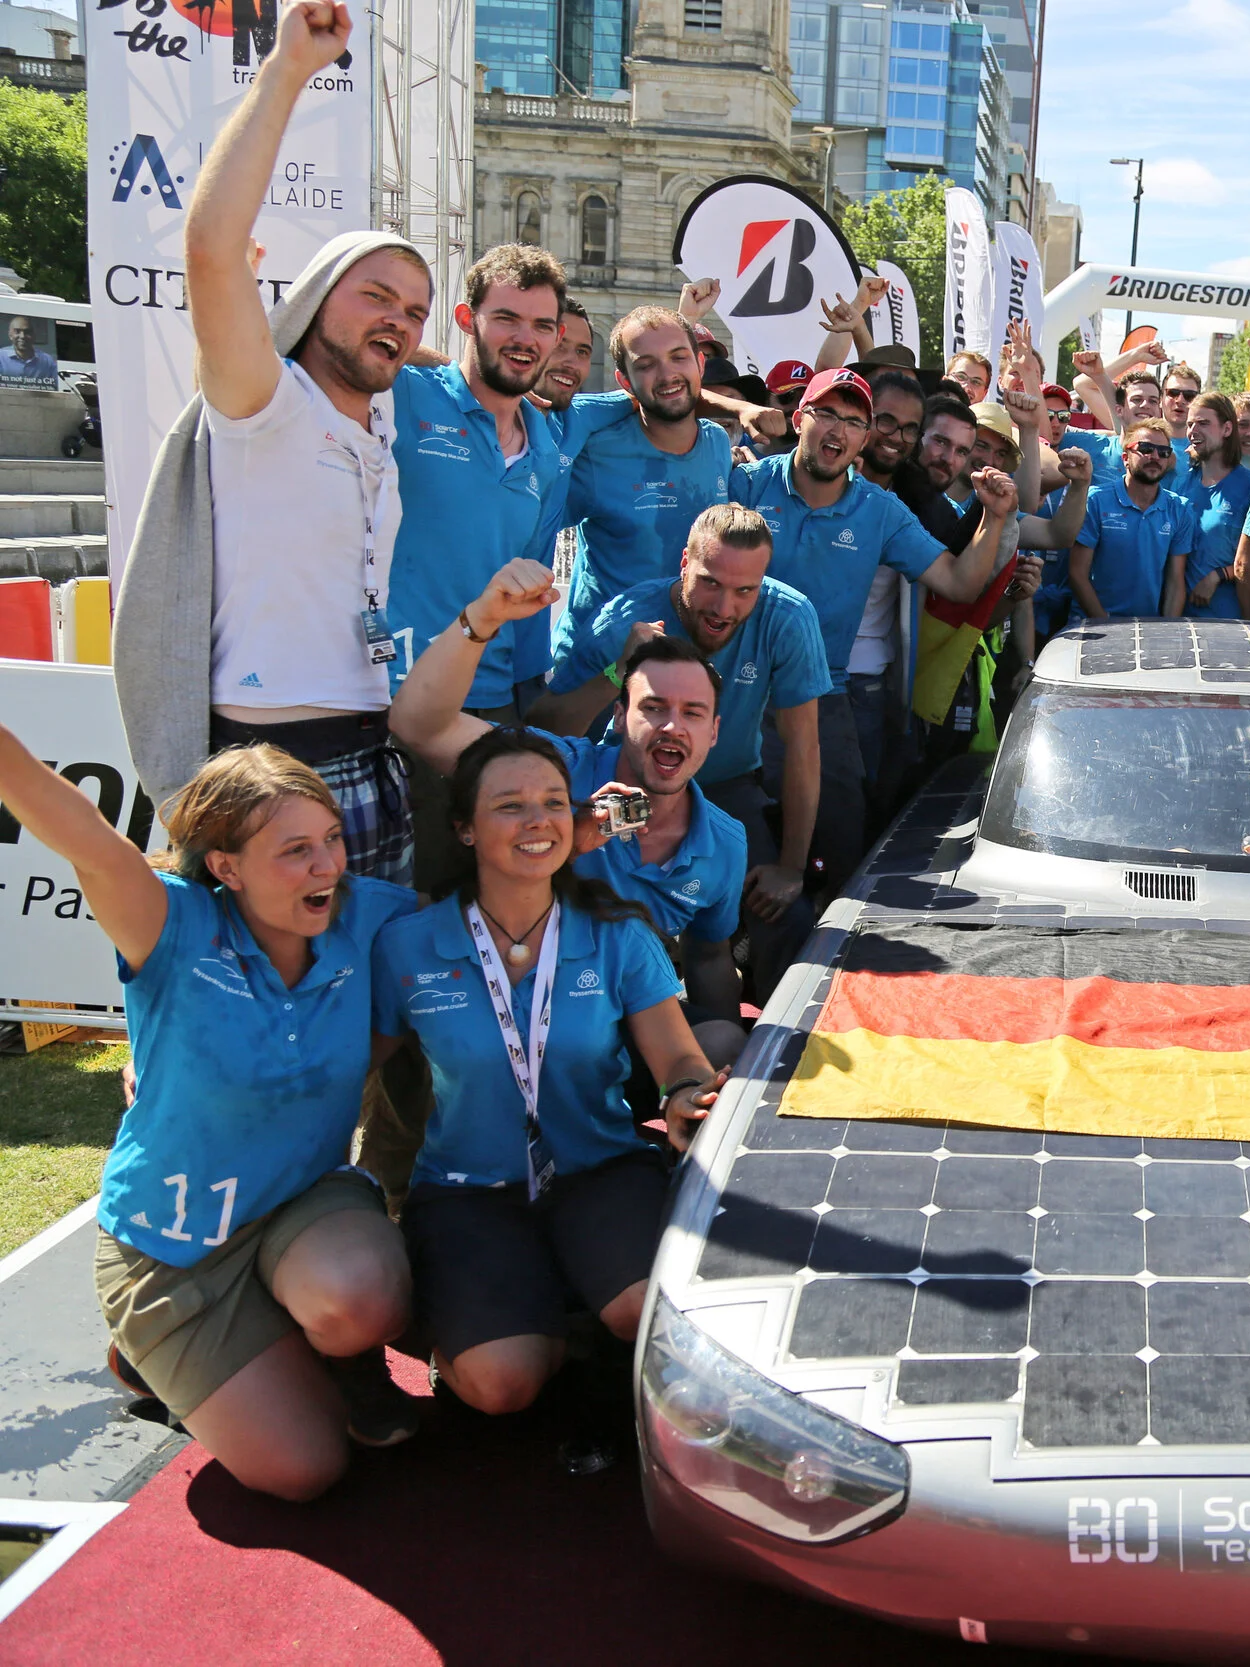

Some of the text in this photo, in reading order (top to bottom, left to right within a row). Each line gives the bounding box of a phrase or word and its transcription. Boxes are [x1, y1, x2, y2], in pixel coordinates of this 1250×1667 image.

[114, 21, 192, 62] the
[284, 162, 316, 183] OF
[262, 186, 344, 210] LAIDE
